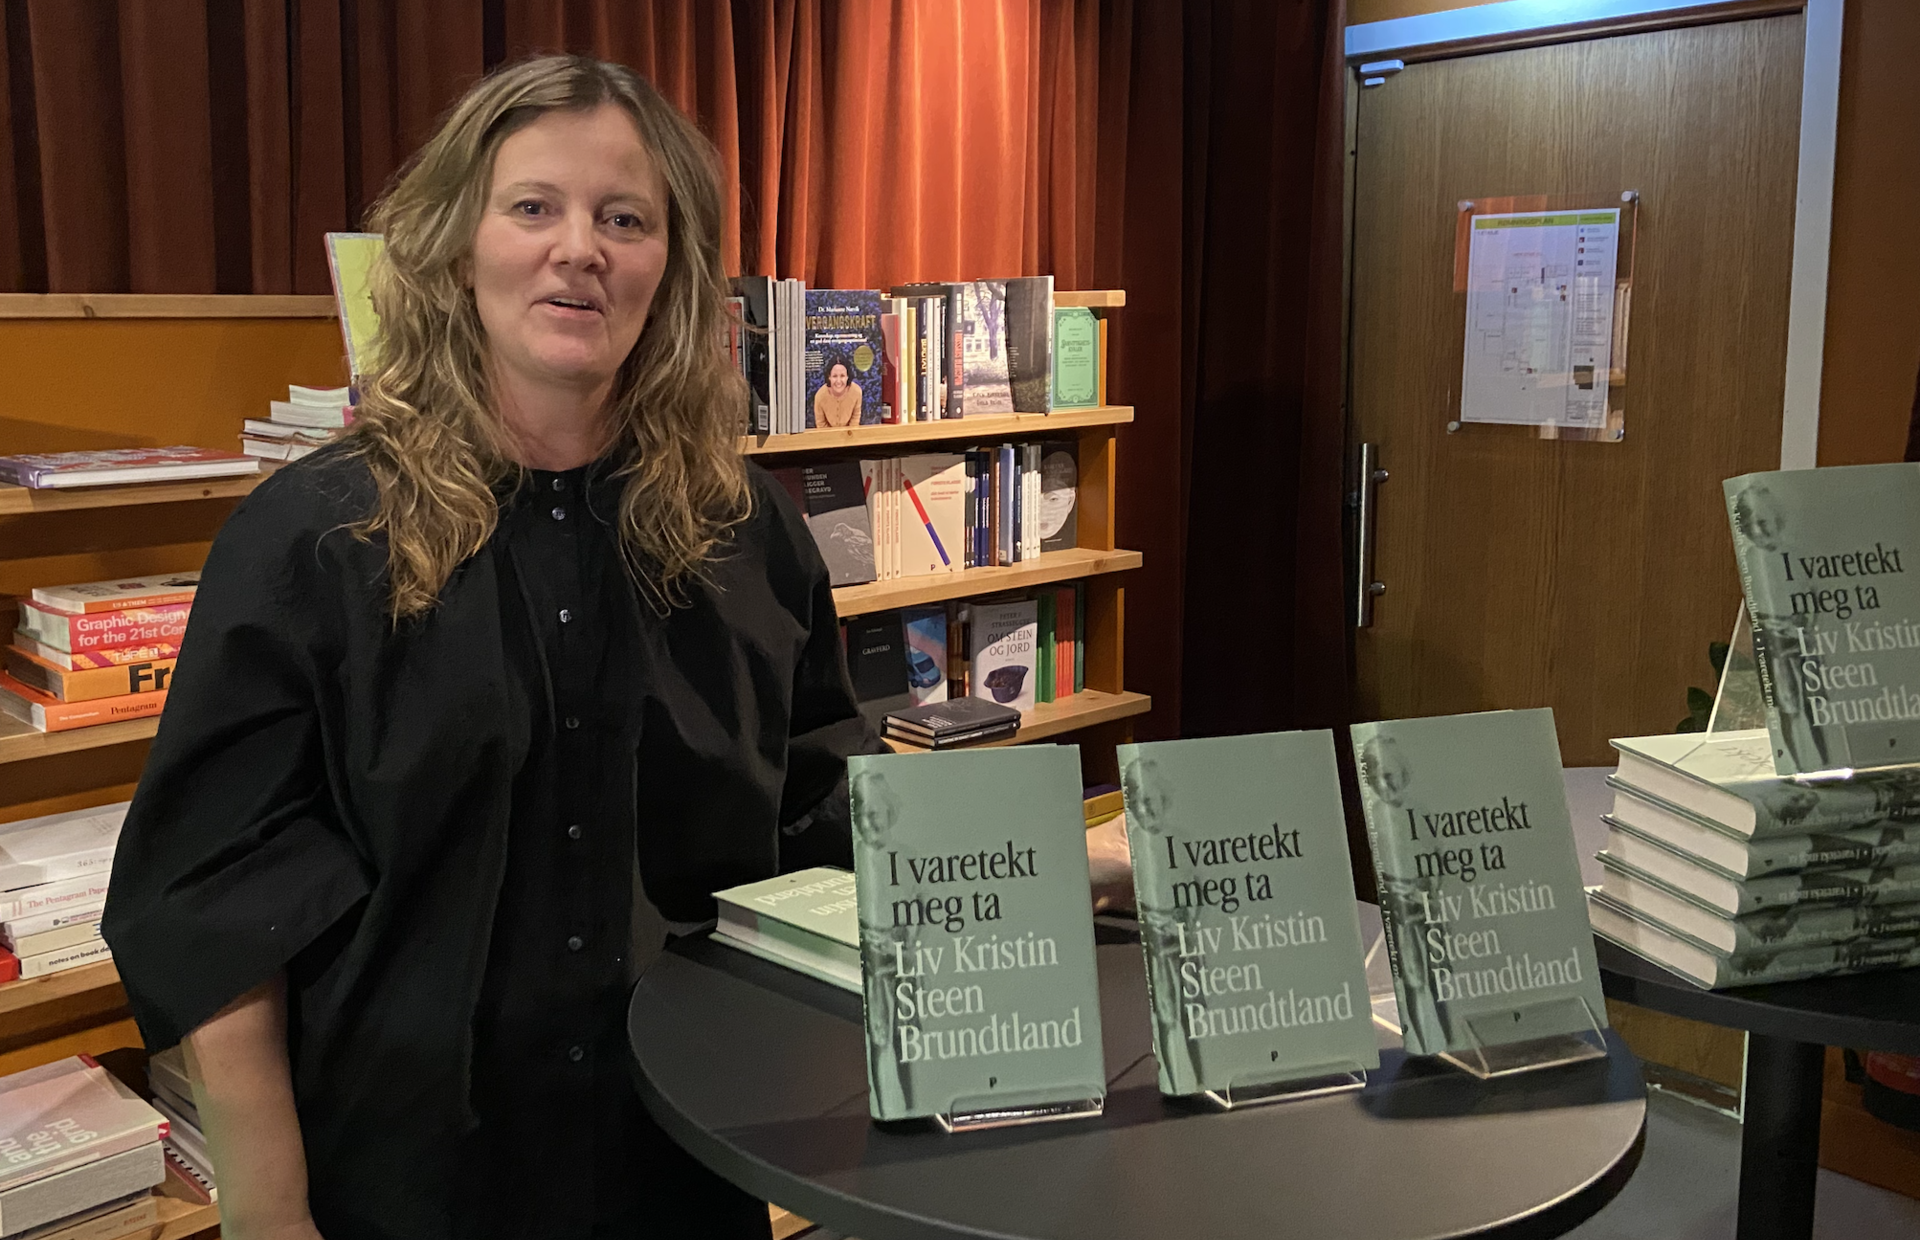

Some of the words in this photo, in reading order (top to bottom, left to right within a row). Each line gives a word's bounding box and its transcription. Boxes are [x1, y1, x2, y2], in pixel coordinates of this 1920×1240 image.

[805, 315, 876, 330] VERGANGSKRAFT
[1781, 552, 1794, 582] I
[1798, 542, 1904, 580] varetekt
[76, 614, 134, 632] Graphic
[137, 609, 186, 625] Design
[1789, 588, 1852, 620] meg
[1858, 585, 1881, 610] ta
[78, 634, 99, 647] for
[102, 631, 126, 644] the
[129, 627, 158, 640] 21st
[160, 624, 187, 636] Cen
[988, 632, 1003, 644] OM
[1006, 629, 1033, 642] STEIN
[989, 645, 1004, 656] OG
[1006, 642, 1030, 656] JORD
[1797, 626, 1839, 657] Liv
[128, 663, 171, 694] Fr
[1758, 652, 1774, 693] varetekt
[1802, 660, 1878, 692] Steen
[111, 702, 157, 715] Pentagram
[1808, 684, 1920, 727] Brundtla
[1406, 808, 1418, 841] I
[1422, 796, 1532, 839] varetekt
[889, 851, 900, 886] I
[908, 840, 1038, 885] varetekt
[1165, 835, 1178, 869] I
[1183, 822, 1303, 867] varetekt
[1414, 848, 1477, 883] meg
[1481, 844, 1506, 872] ta
[27, 900, 44, 909] The
[45, 890, 87, 905] Pentagram
[754, 873, 856, 906] rundtland
[1172, 875, 1240, 913] meg
[1246, 872, 1273, 902] ta
[1421, 889, 1463, 925] Liv
[1468, 880, 1556, 919] Kristin
[892, 895, 964, 933] meg
[974, 890, 1002, 922] ta
[1176, 919, 1222, 958] Liv
[1228, 911, 1328, 953] Kristin
[1426, 927, 1501, 964] Steen
[49, 957, 69, 966] notes
[80, 949, 99, 958] book
[893, 939, 944, 979] Liv
[954, 931, 1058, 973] Kristin
[1180, 961, 1263, 998] Steen
[1431, 947, 1583, 1003] Brundtland
[896, 983, 984, 1021] Steen
[1185, 982, 1353, 1040] Brundtland
[898, 1007, 1083, 1063] Brundtland
